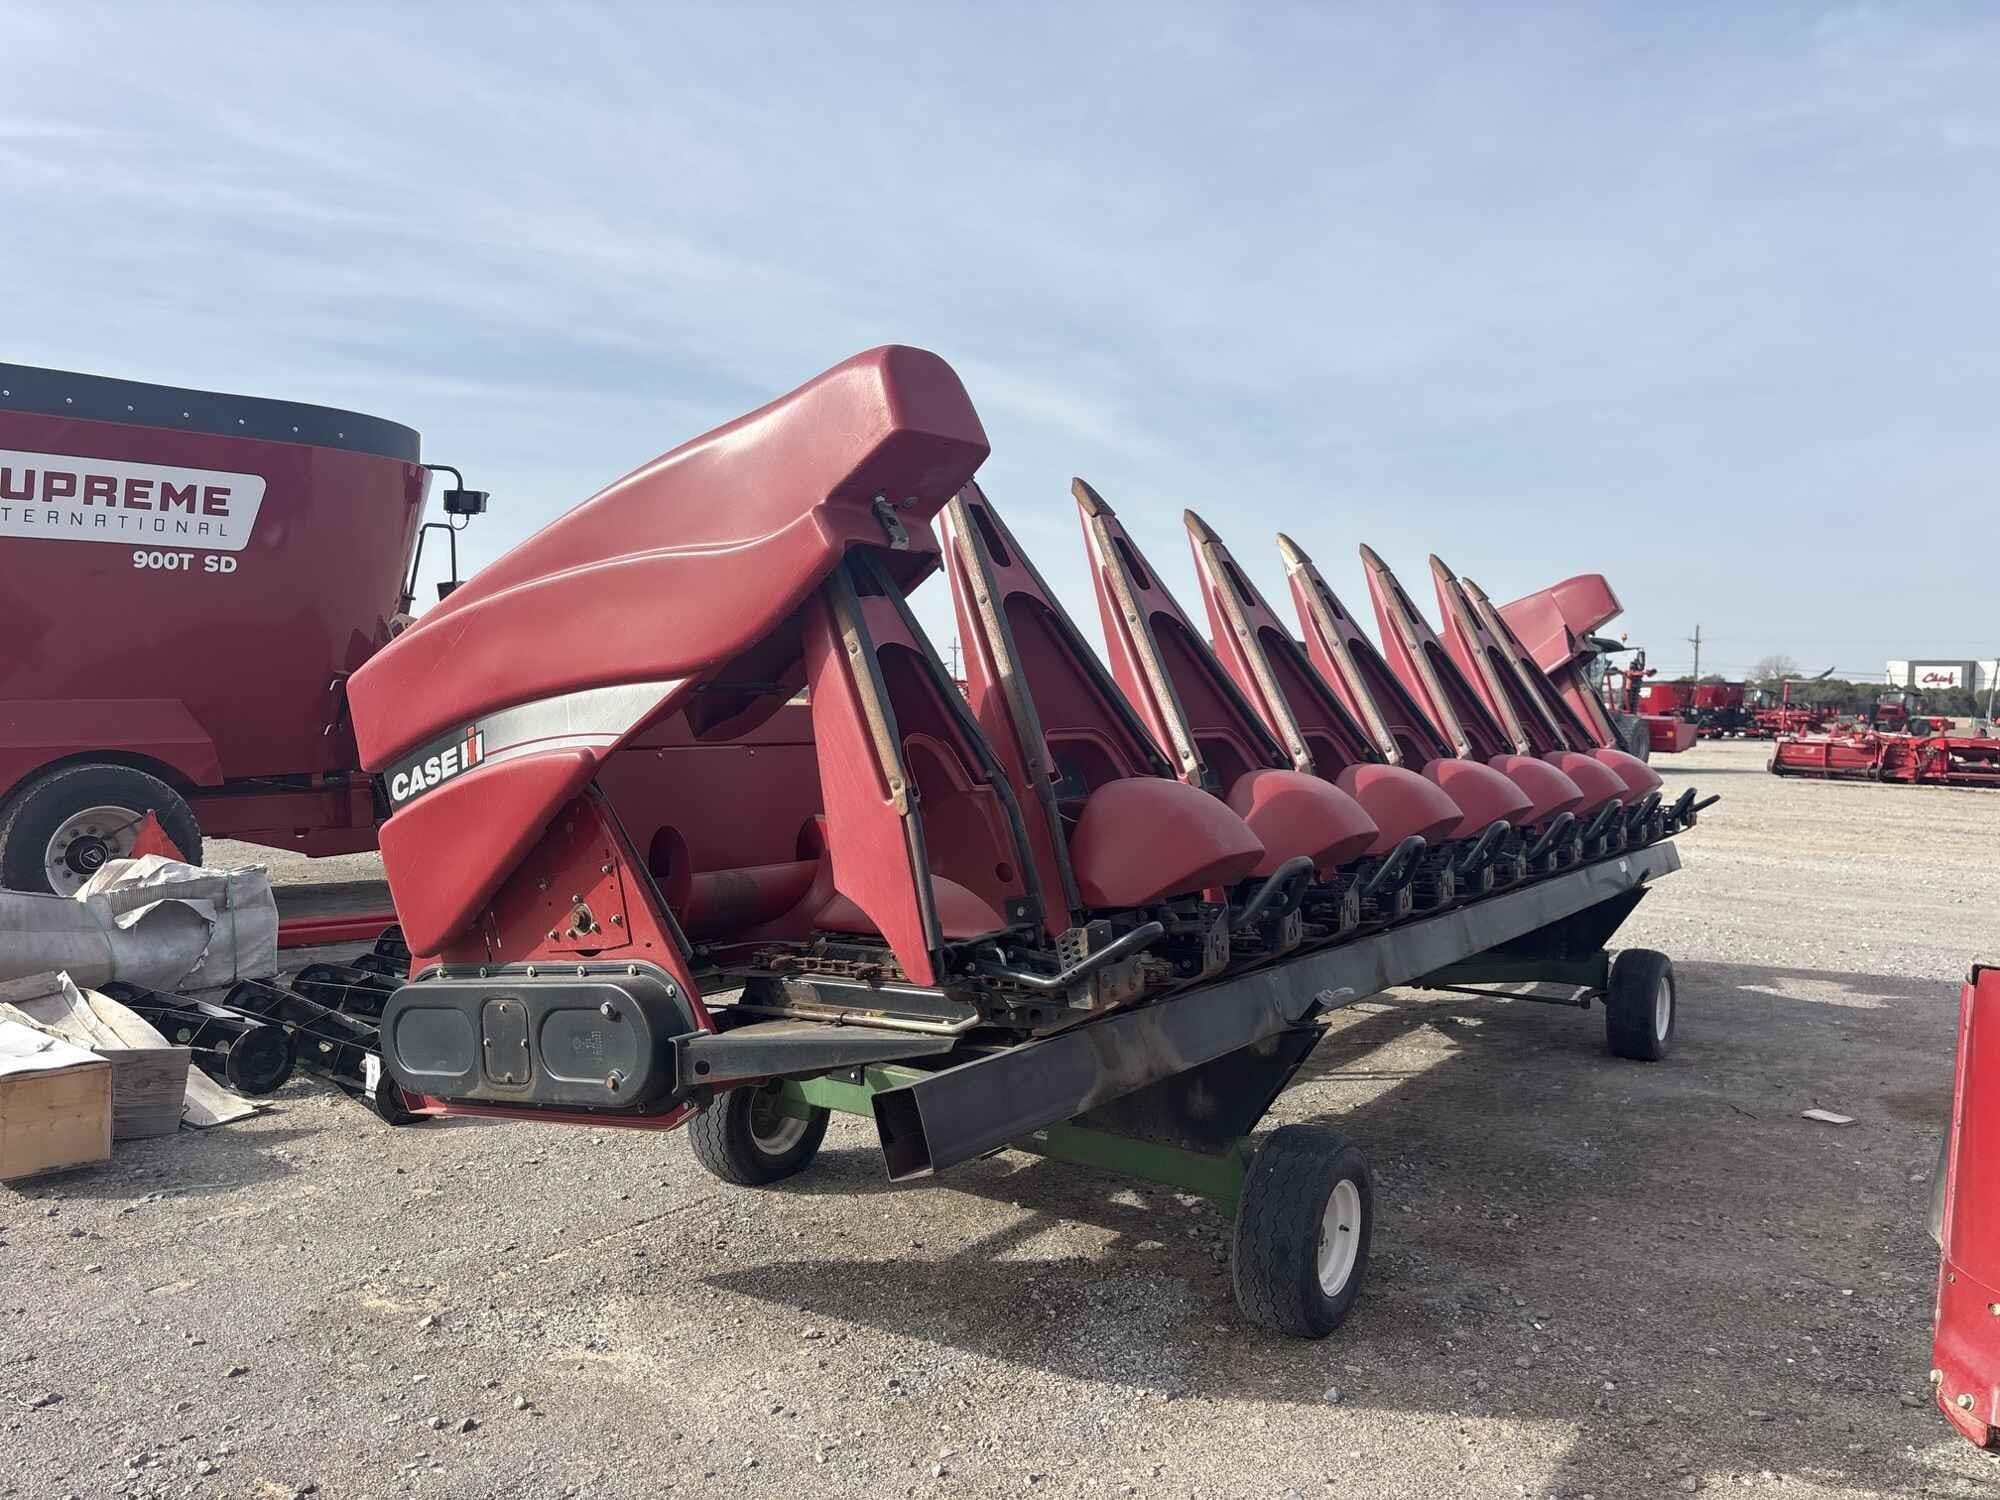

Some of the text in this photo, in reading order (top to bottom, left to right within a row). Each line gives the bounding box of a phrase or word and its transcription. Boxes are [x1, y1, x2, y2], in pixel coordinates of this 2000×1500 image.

[0, 467, 231, 517] UPREME
[133, 550, 237, 573] 900T SD
[391, 746, 458, 801] CASE
